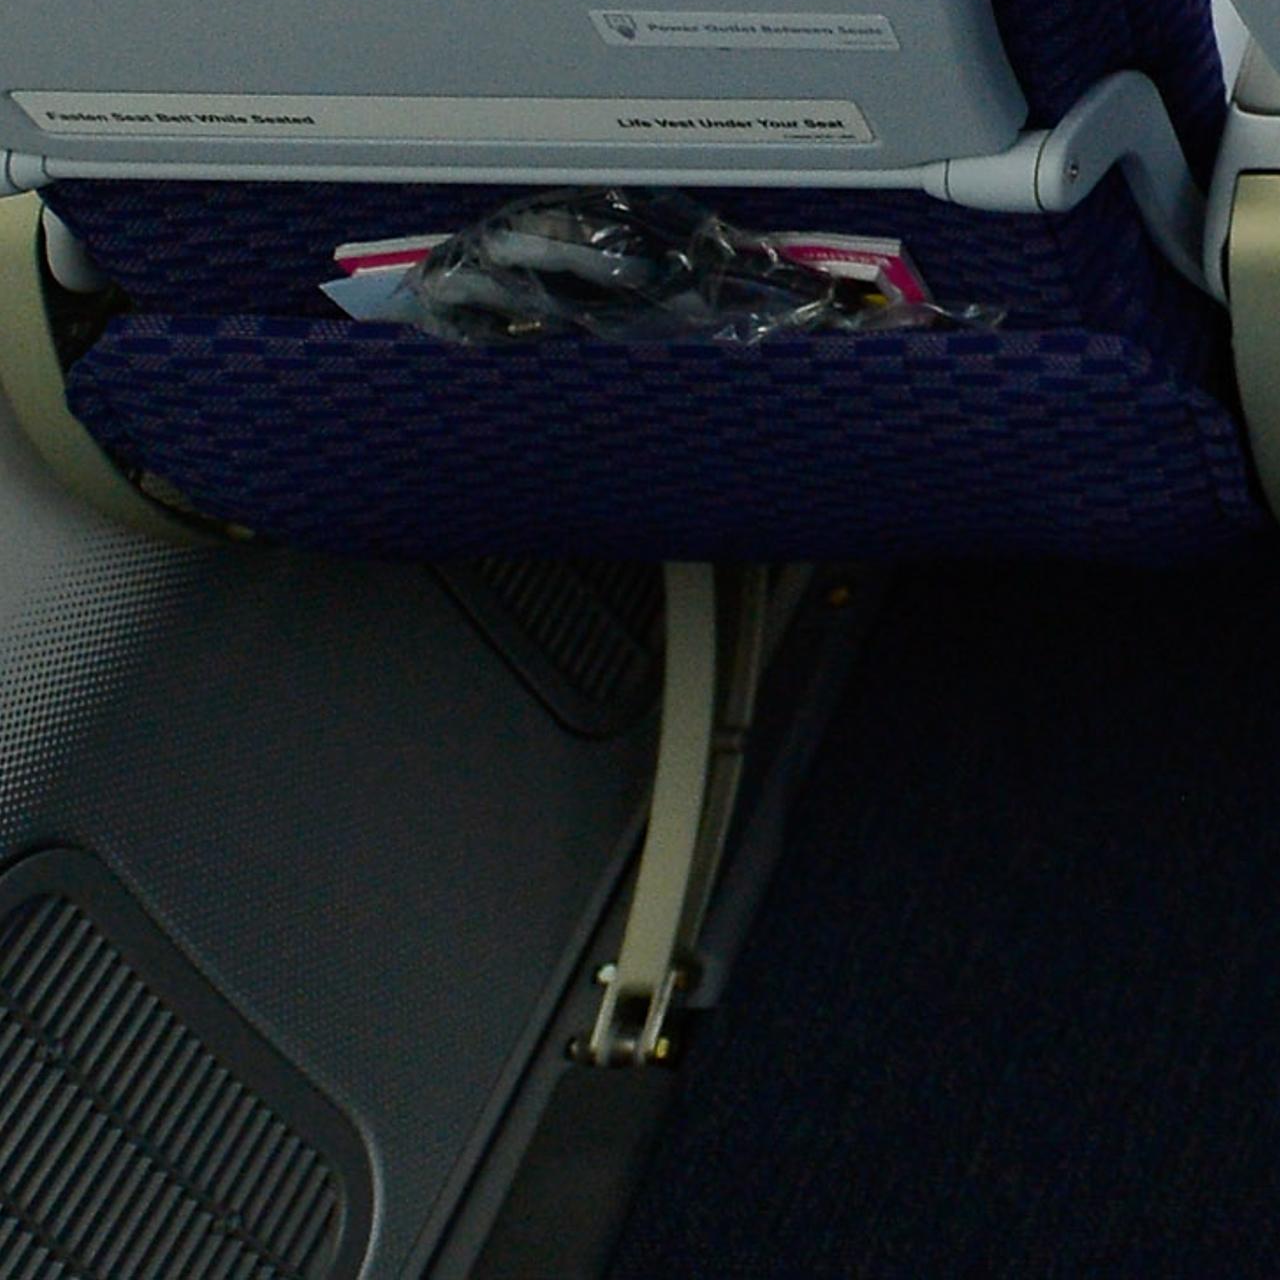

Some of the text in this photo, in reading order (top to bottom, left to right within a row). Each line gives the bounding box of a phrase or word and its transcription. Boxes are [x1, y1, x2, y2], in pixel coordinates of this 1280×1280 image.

[46, 110, 316, 126] Fasten Seat Belt While Seated
[617, 118, 844, 129] Life Vest Under Your Seat
